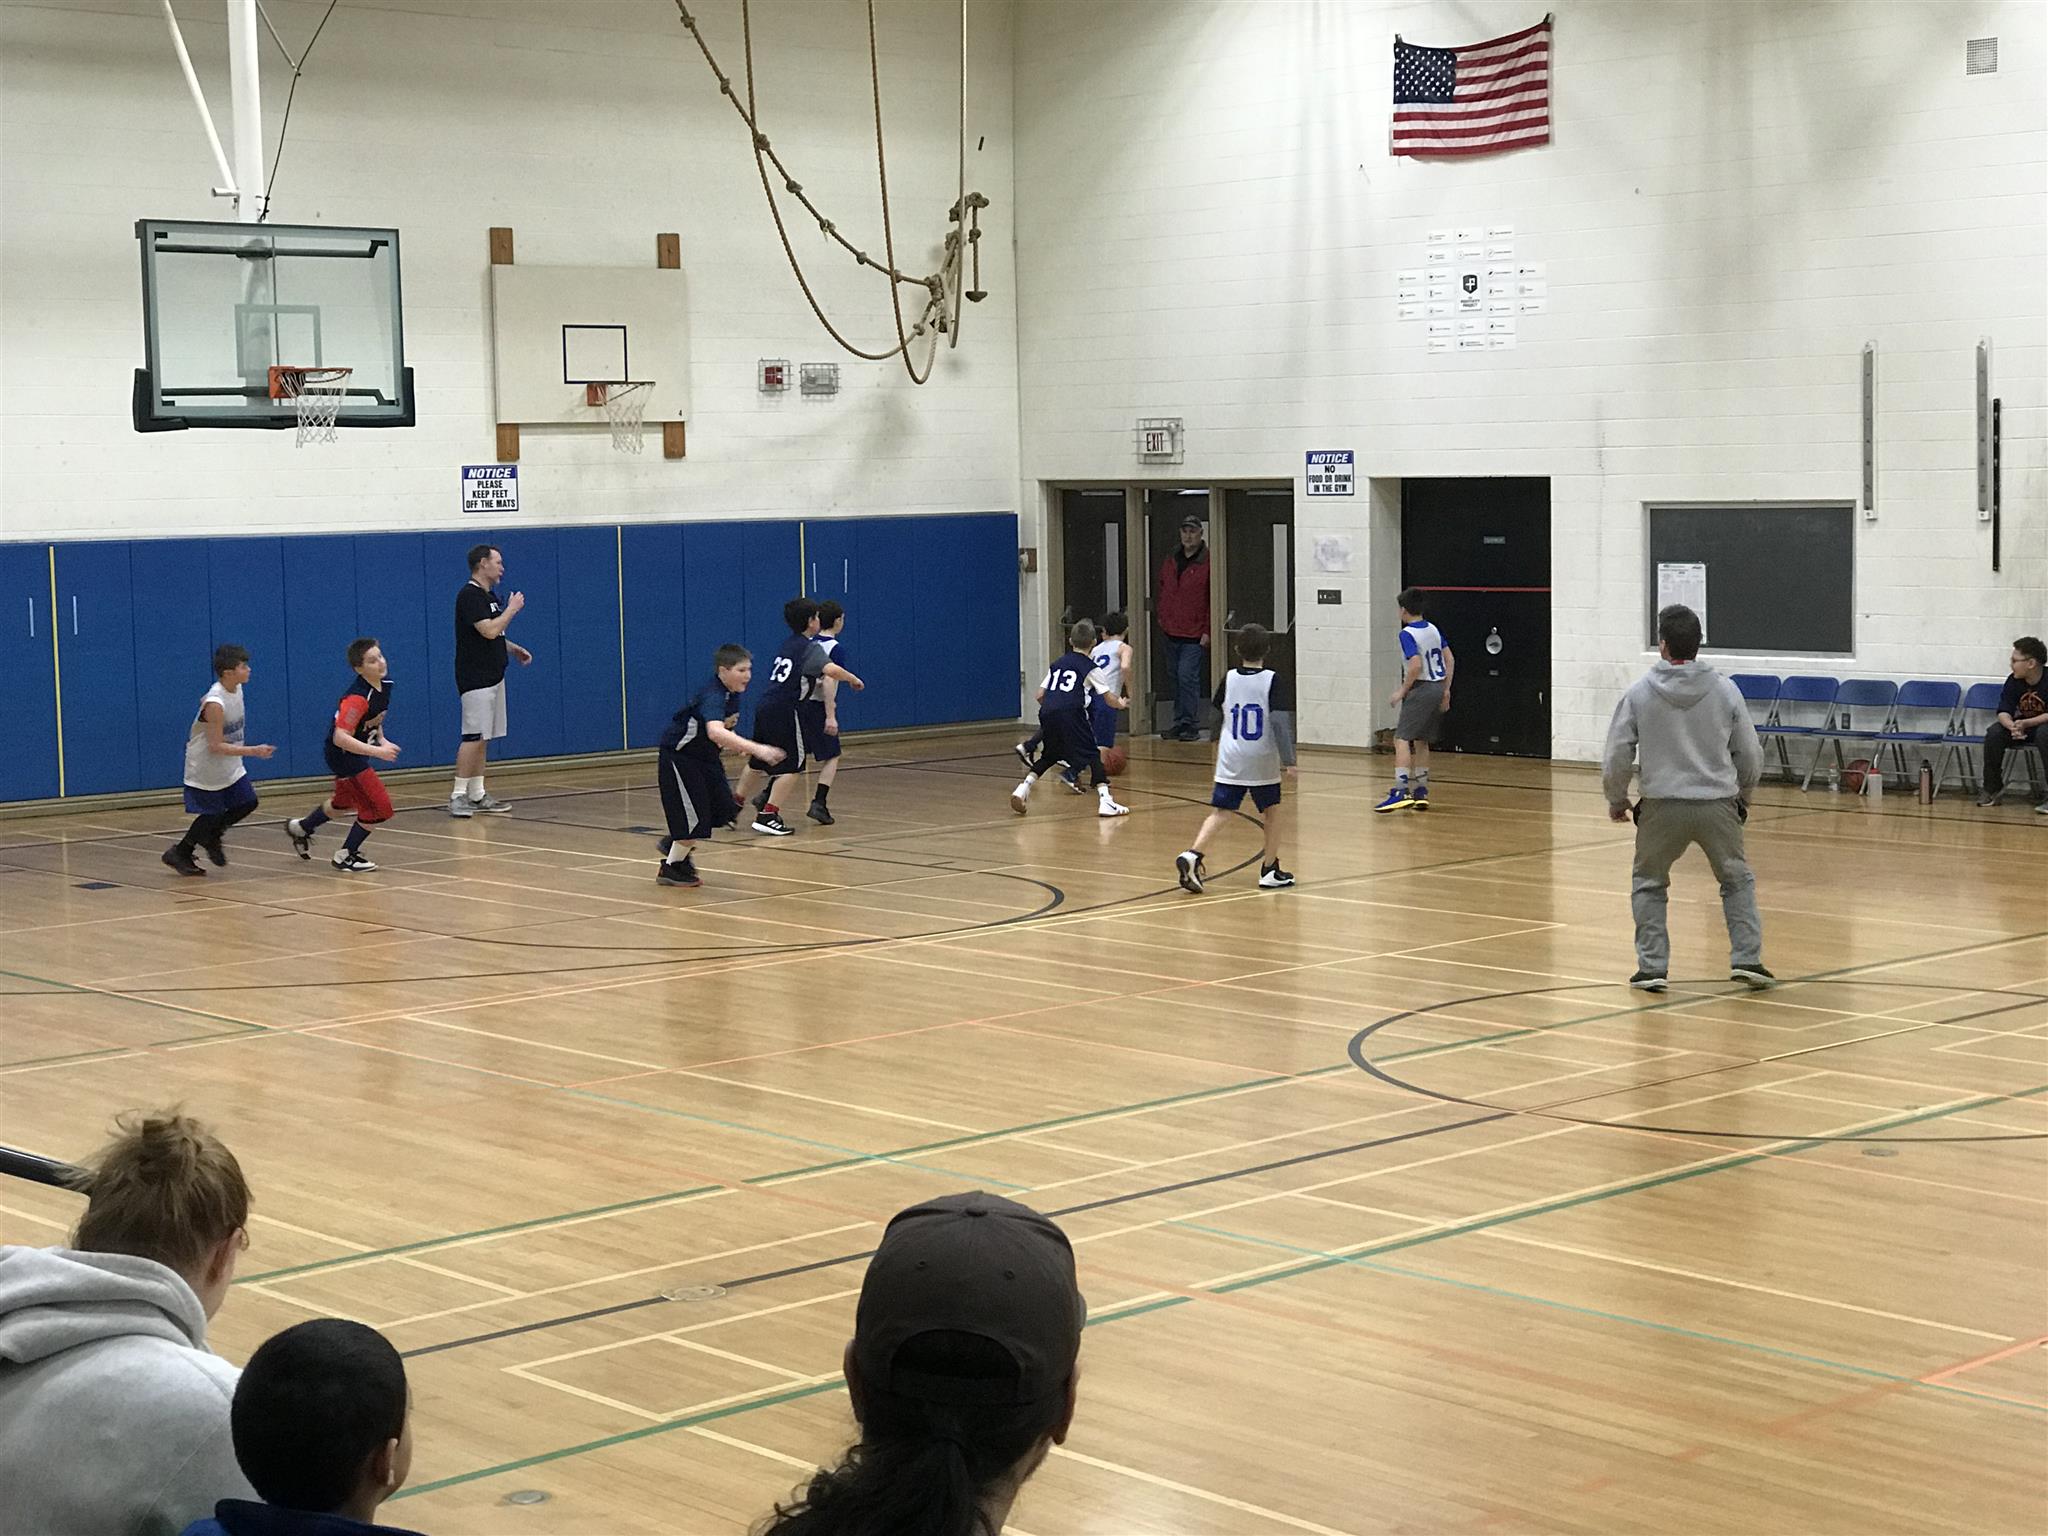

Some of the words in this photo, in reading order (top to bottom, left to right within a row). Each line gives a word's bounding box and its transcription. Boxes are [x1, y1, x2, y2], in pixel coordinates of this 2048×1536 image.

[1146, 432, 1164, 452] EXIT
[1311, 453, 1349, 464] NOTICE
[467, 468, 512, 479] NOTICE
[1324, 465, 1336, 474] NO
[477, 480, 503, 489] PLEASE
[1321, 484, 1333, 493] THE
[472, 490, 490, 499] KEEP
[491, 489, 508, 498] FEET
[465, 500, 478, 509] OFF
[480, 499, 494, 508] THE
[496, 499, 516, 508] MATS
[1425, 647, 1446, 680] 13
[1049, 668, 1077, 693] 13
[1230, 702, 1264, 741] 10
